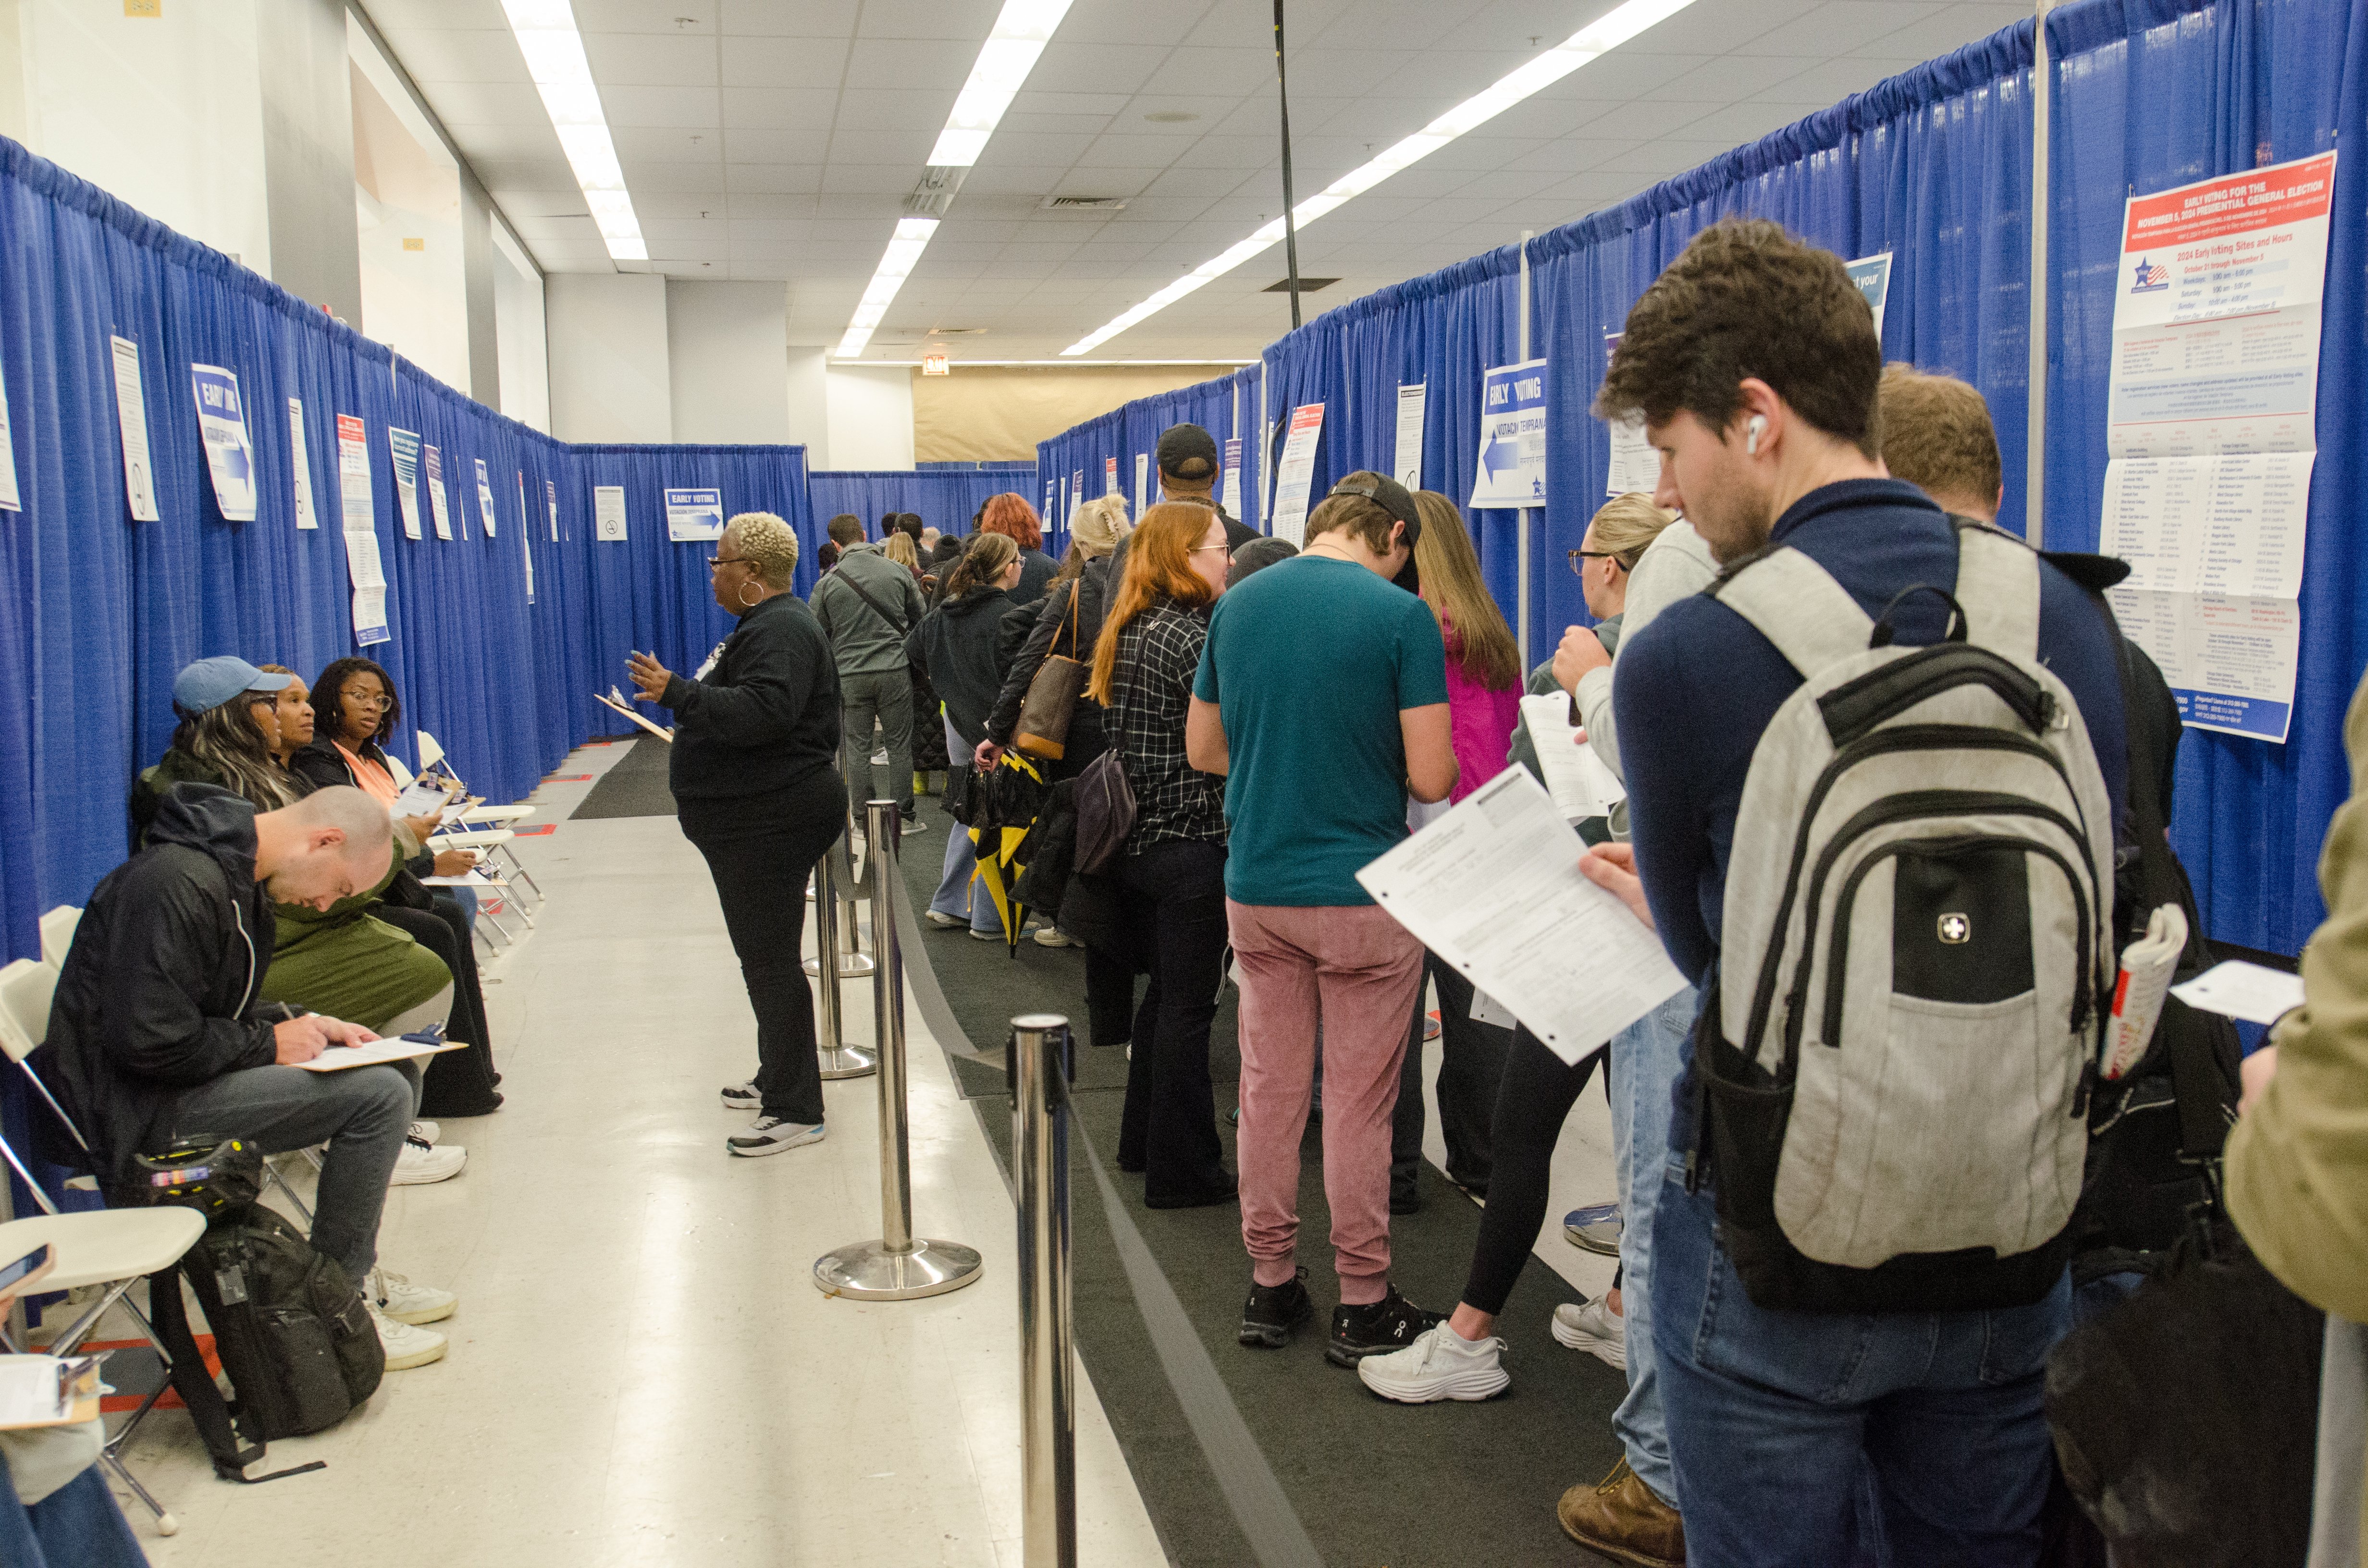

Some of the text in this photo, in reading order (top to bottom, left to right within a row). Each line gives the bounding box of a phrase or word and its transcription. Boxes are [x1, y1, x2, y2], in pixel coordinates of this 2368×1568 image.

[2229, 185, 2247, 198] FOR
[2248, 181, 2266, 194] THE
[2137, 213, 2173, 229] NOVEMBER
[2247, 190, 2285, 206] GENERAL
[2287, 179, 2324, 198] ELECTION
[2177, 251, 2193, 262] 2024
[2195, 248, 2209, 258] Early
[2236, 241, 2255, 251] Sites
[2257, 236, 2270, 247] and
[2272, 233, 2293, 245] Hours
[2184, 265, 2203, 274] October
[2232, 255, 2259, 265] November
[1861, 273, 1878, 289] your
[925, 356, 945, 370] EXIT
[1490, 383, 1509, 405] EARLY
[672, 494, 715, 503] EARLY VOTING
